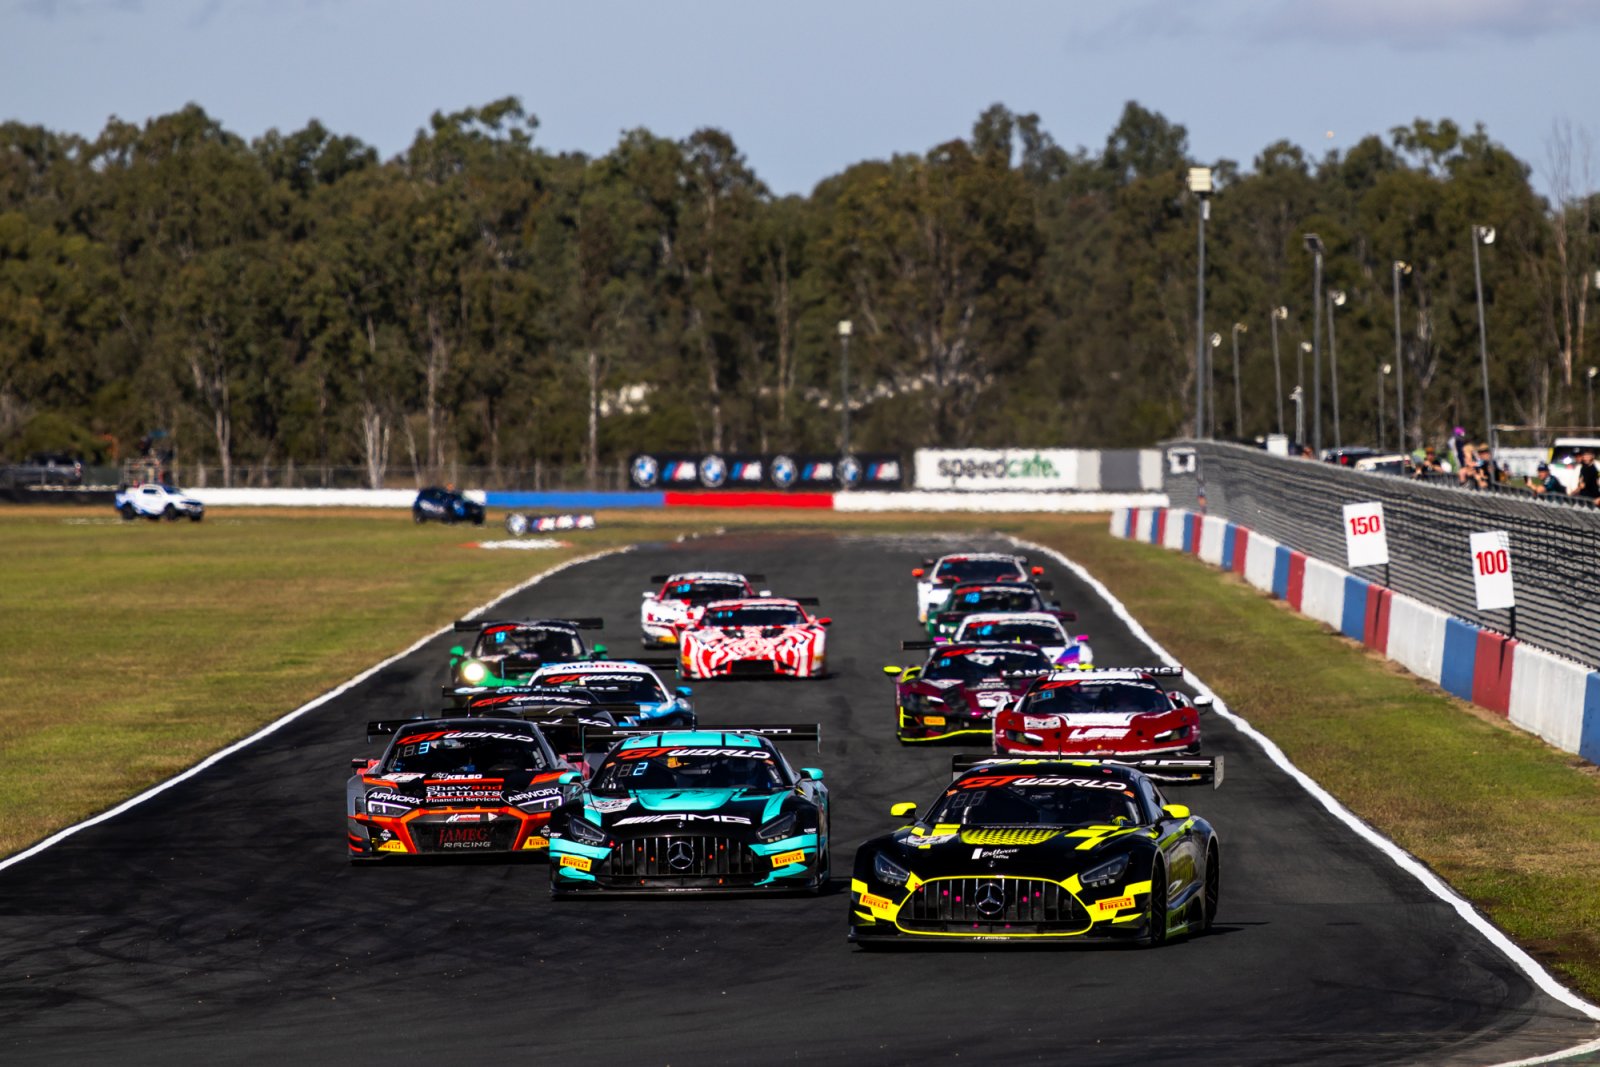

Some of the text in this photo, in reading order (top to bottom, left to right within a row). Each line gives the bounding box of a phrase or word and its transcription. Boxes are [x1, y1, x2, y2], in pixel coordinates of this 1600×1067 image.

[1349, 515, 1381, 536] 150
[1476, 549, 1508, 576] 100
[667, 750, 771, 759] WORLD
[1013, 778, 1128, 790] WORLD
[369, 791, 424, 805] AIRWORX
[508, 787, 562, 803] AIRWORX
[562, 856, 590, 869] PIRELLI
[774, 852, 803, 865] PIRELLI
[861, 894, 889, 911] PIRELLI
[1099, 898, 1132, 912] PIRELLI
